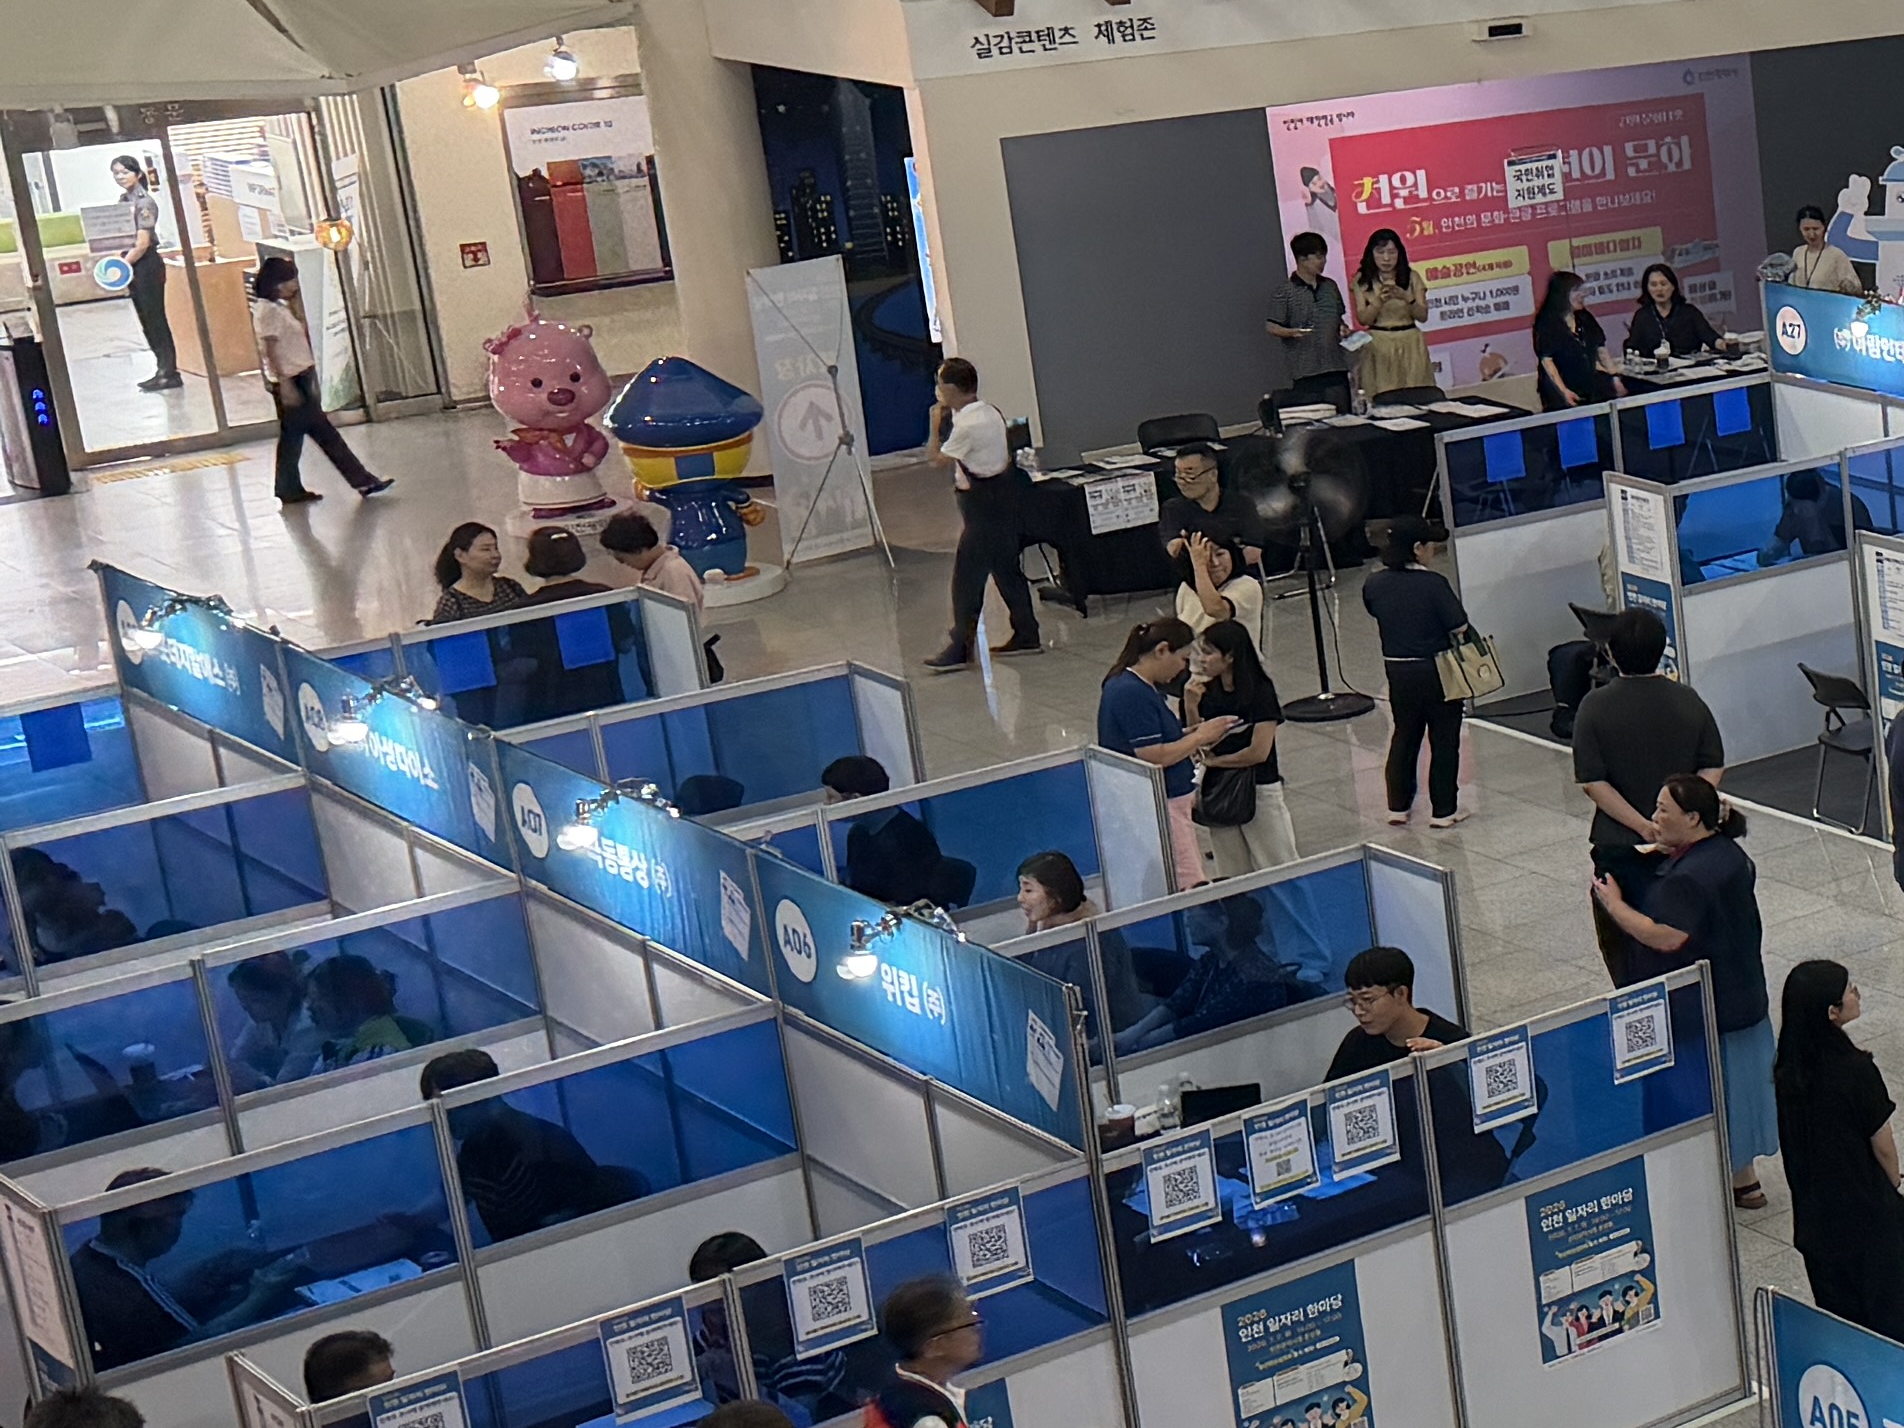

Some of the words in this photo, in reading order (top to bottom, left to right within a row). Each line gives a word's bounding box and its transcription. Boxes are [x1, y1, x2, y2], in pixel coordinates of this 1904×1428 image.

[969, 24, 1079, 60] 실감콘텐츠
[1093, 15, 1158, 50] 체험존
[1624, 134, 1692, 178] 문화
[1513, 163, 1555, 183] 국민취업
[1780, 321, 1801, 339] A27
[783, 923, 812, 960] A06
[1238, 1323, 1265, 1343] 인천
